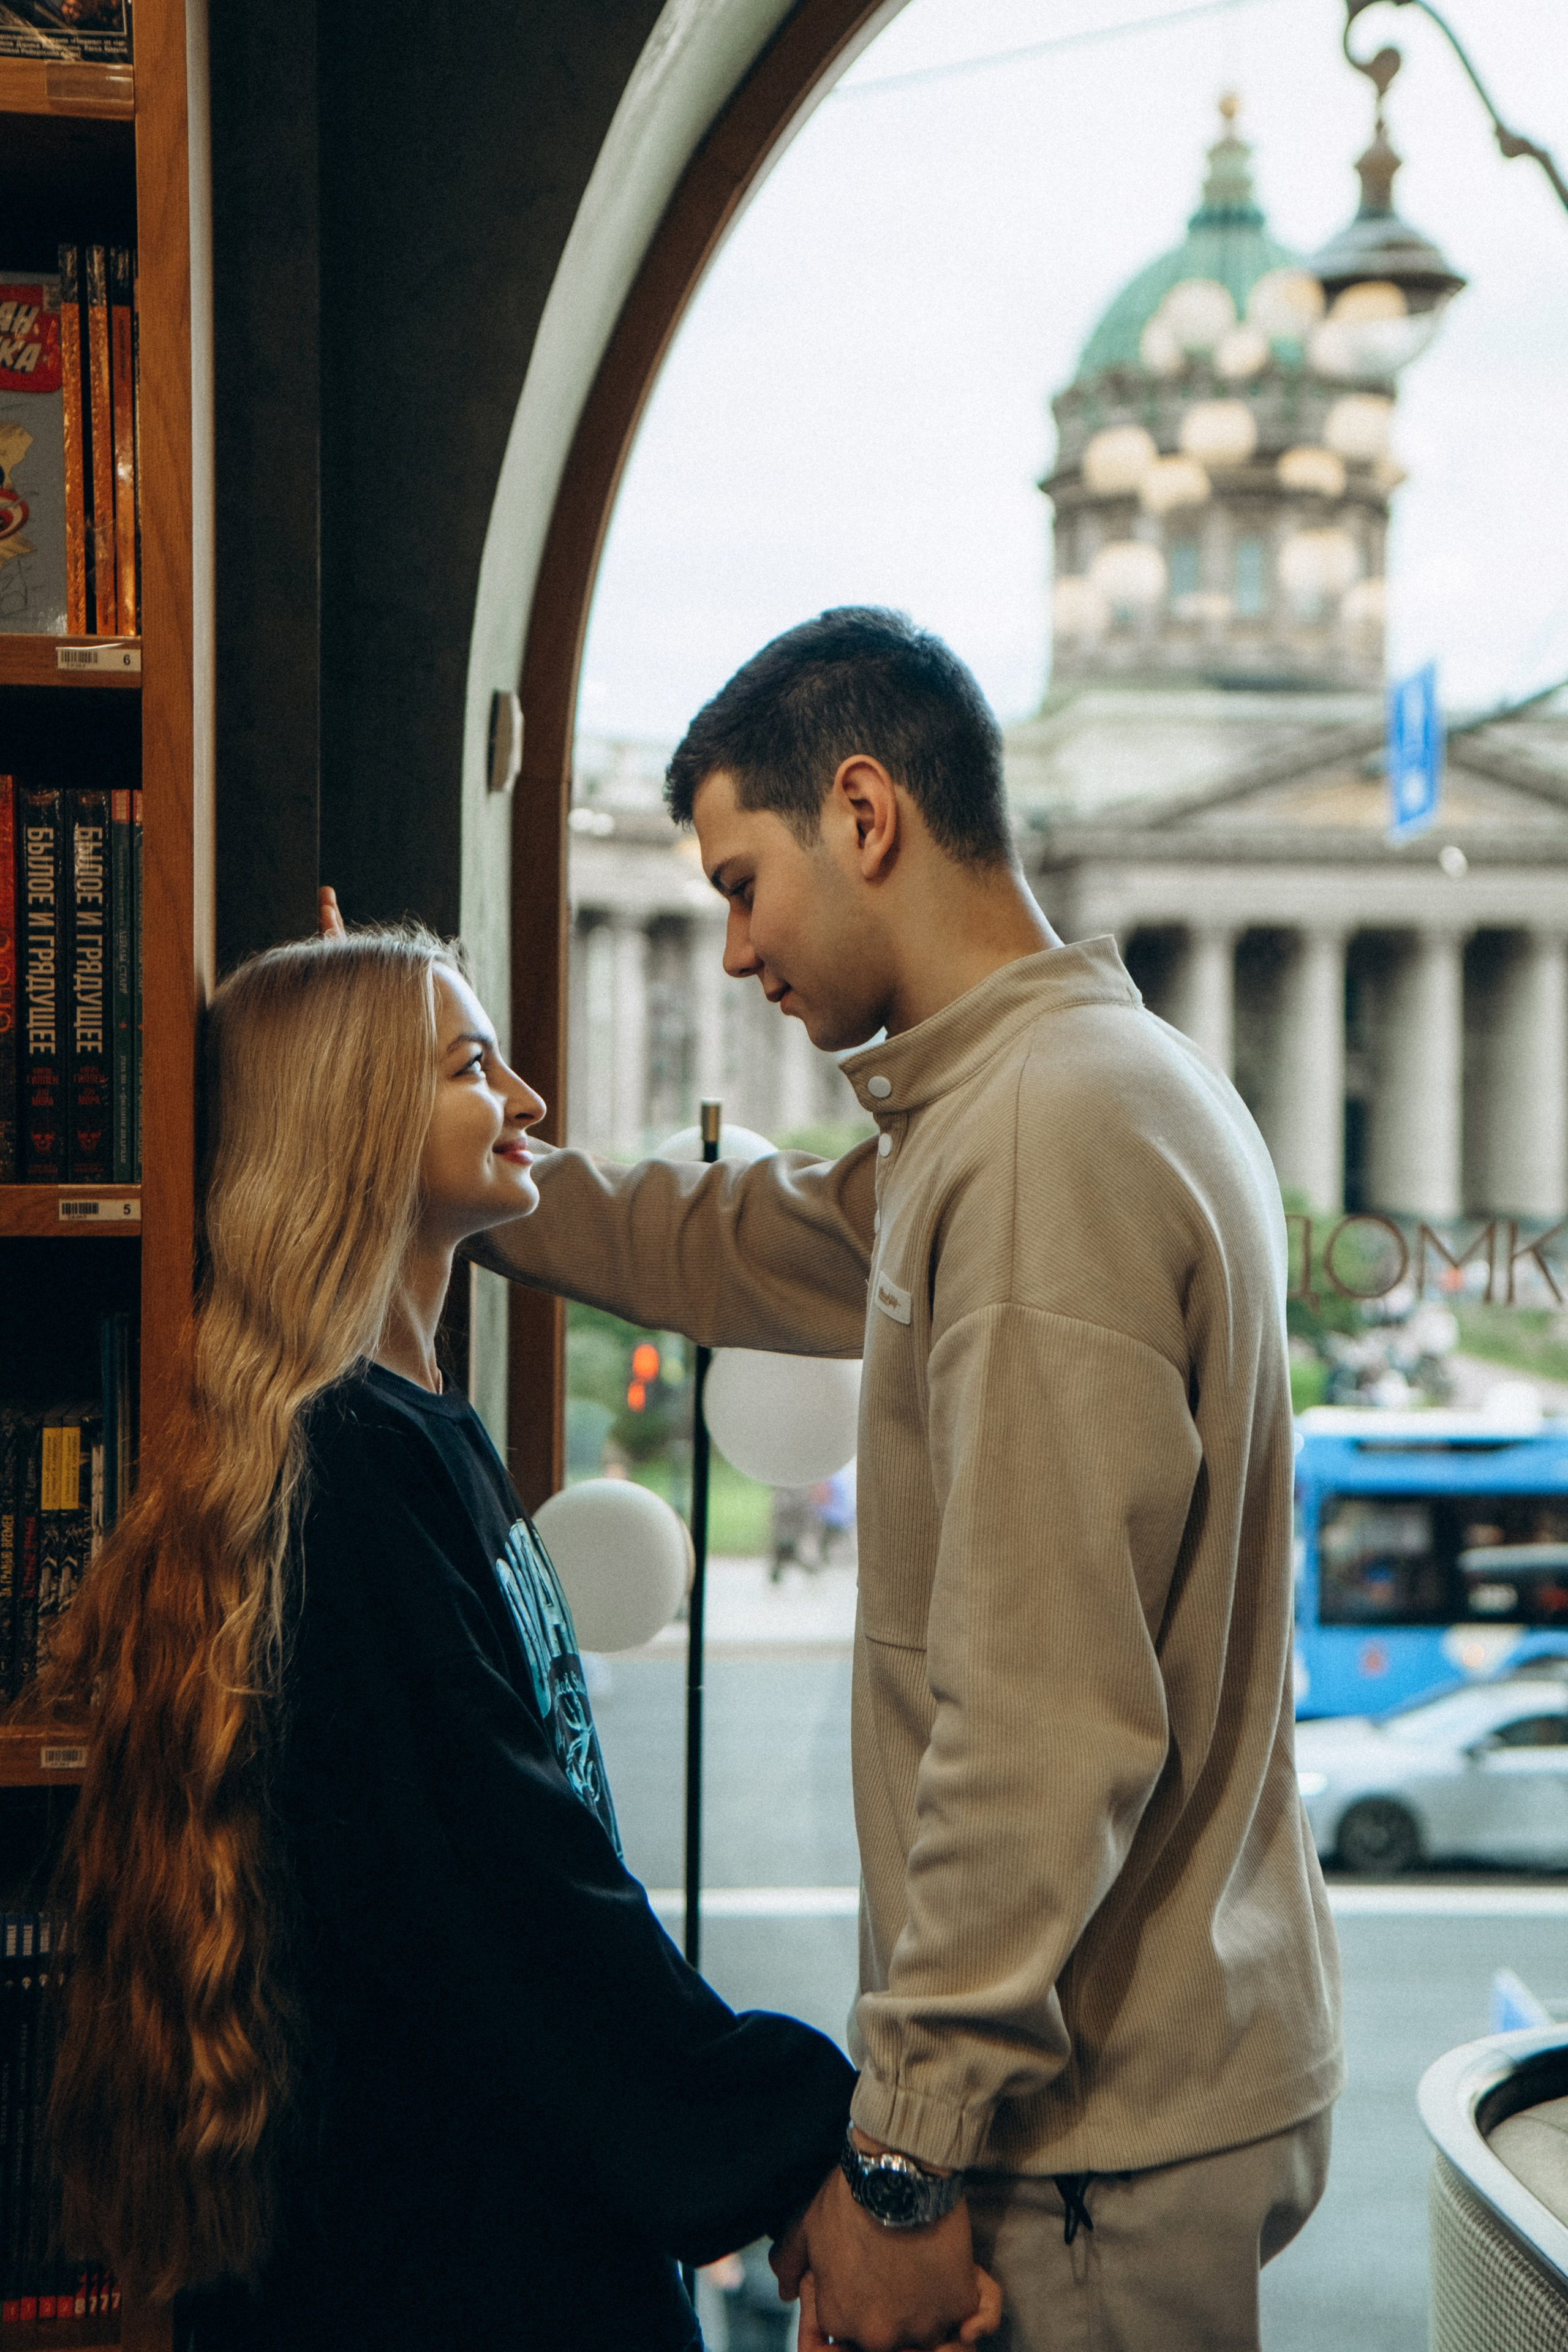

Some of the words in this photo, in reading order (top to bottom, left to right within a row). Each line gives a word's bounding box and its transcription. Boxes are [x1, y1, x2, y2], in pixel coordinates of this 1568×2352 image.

[123, 654, 131, 666] 6
[27, 827, 55, 905] БЫЛОЕ
[75, 827, 103, 905] БЫЛОЕ
[28, 912, 55, 927] И
[75, 911, 103, 926] И
[73, 934, 103, 1054] ГРЯДУЩЕЕ
[119, 965, 129, 994] СТАРР
[26, 935, 56, 1055] ГРЯДУЩЕЕ
[123, 1204, 131, 1215] 5
